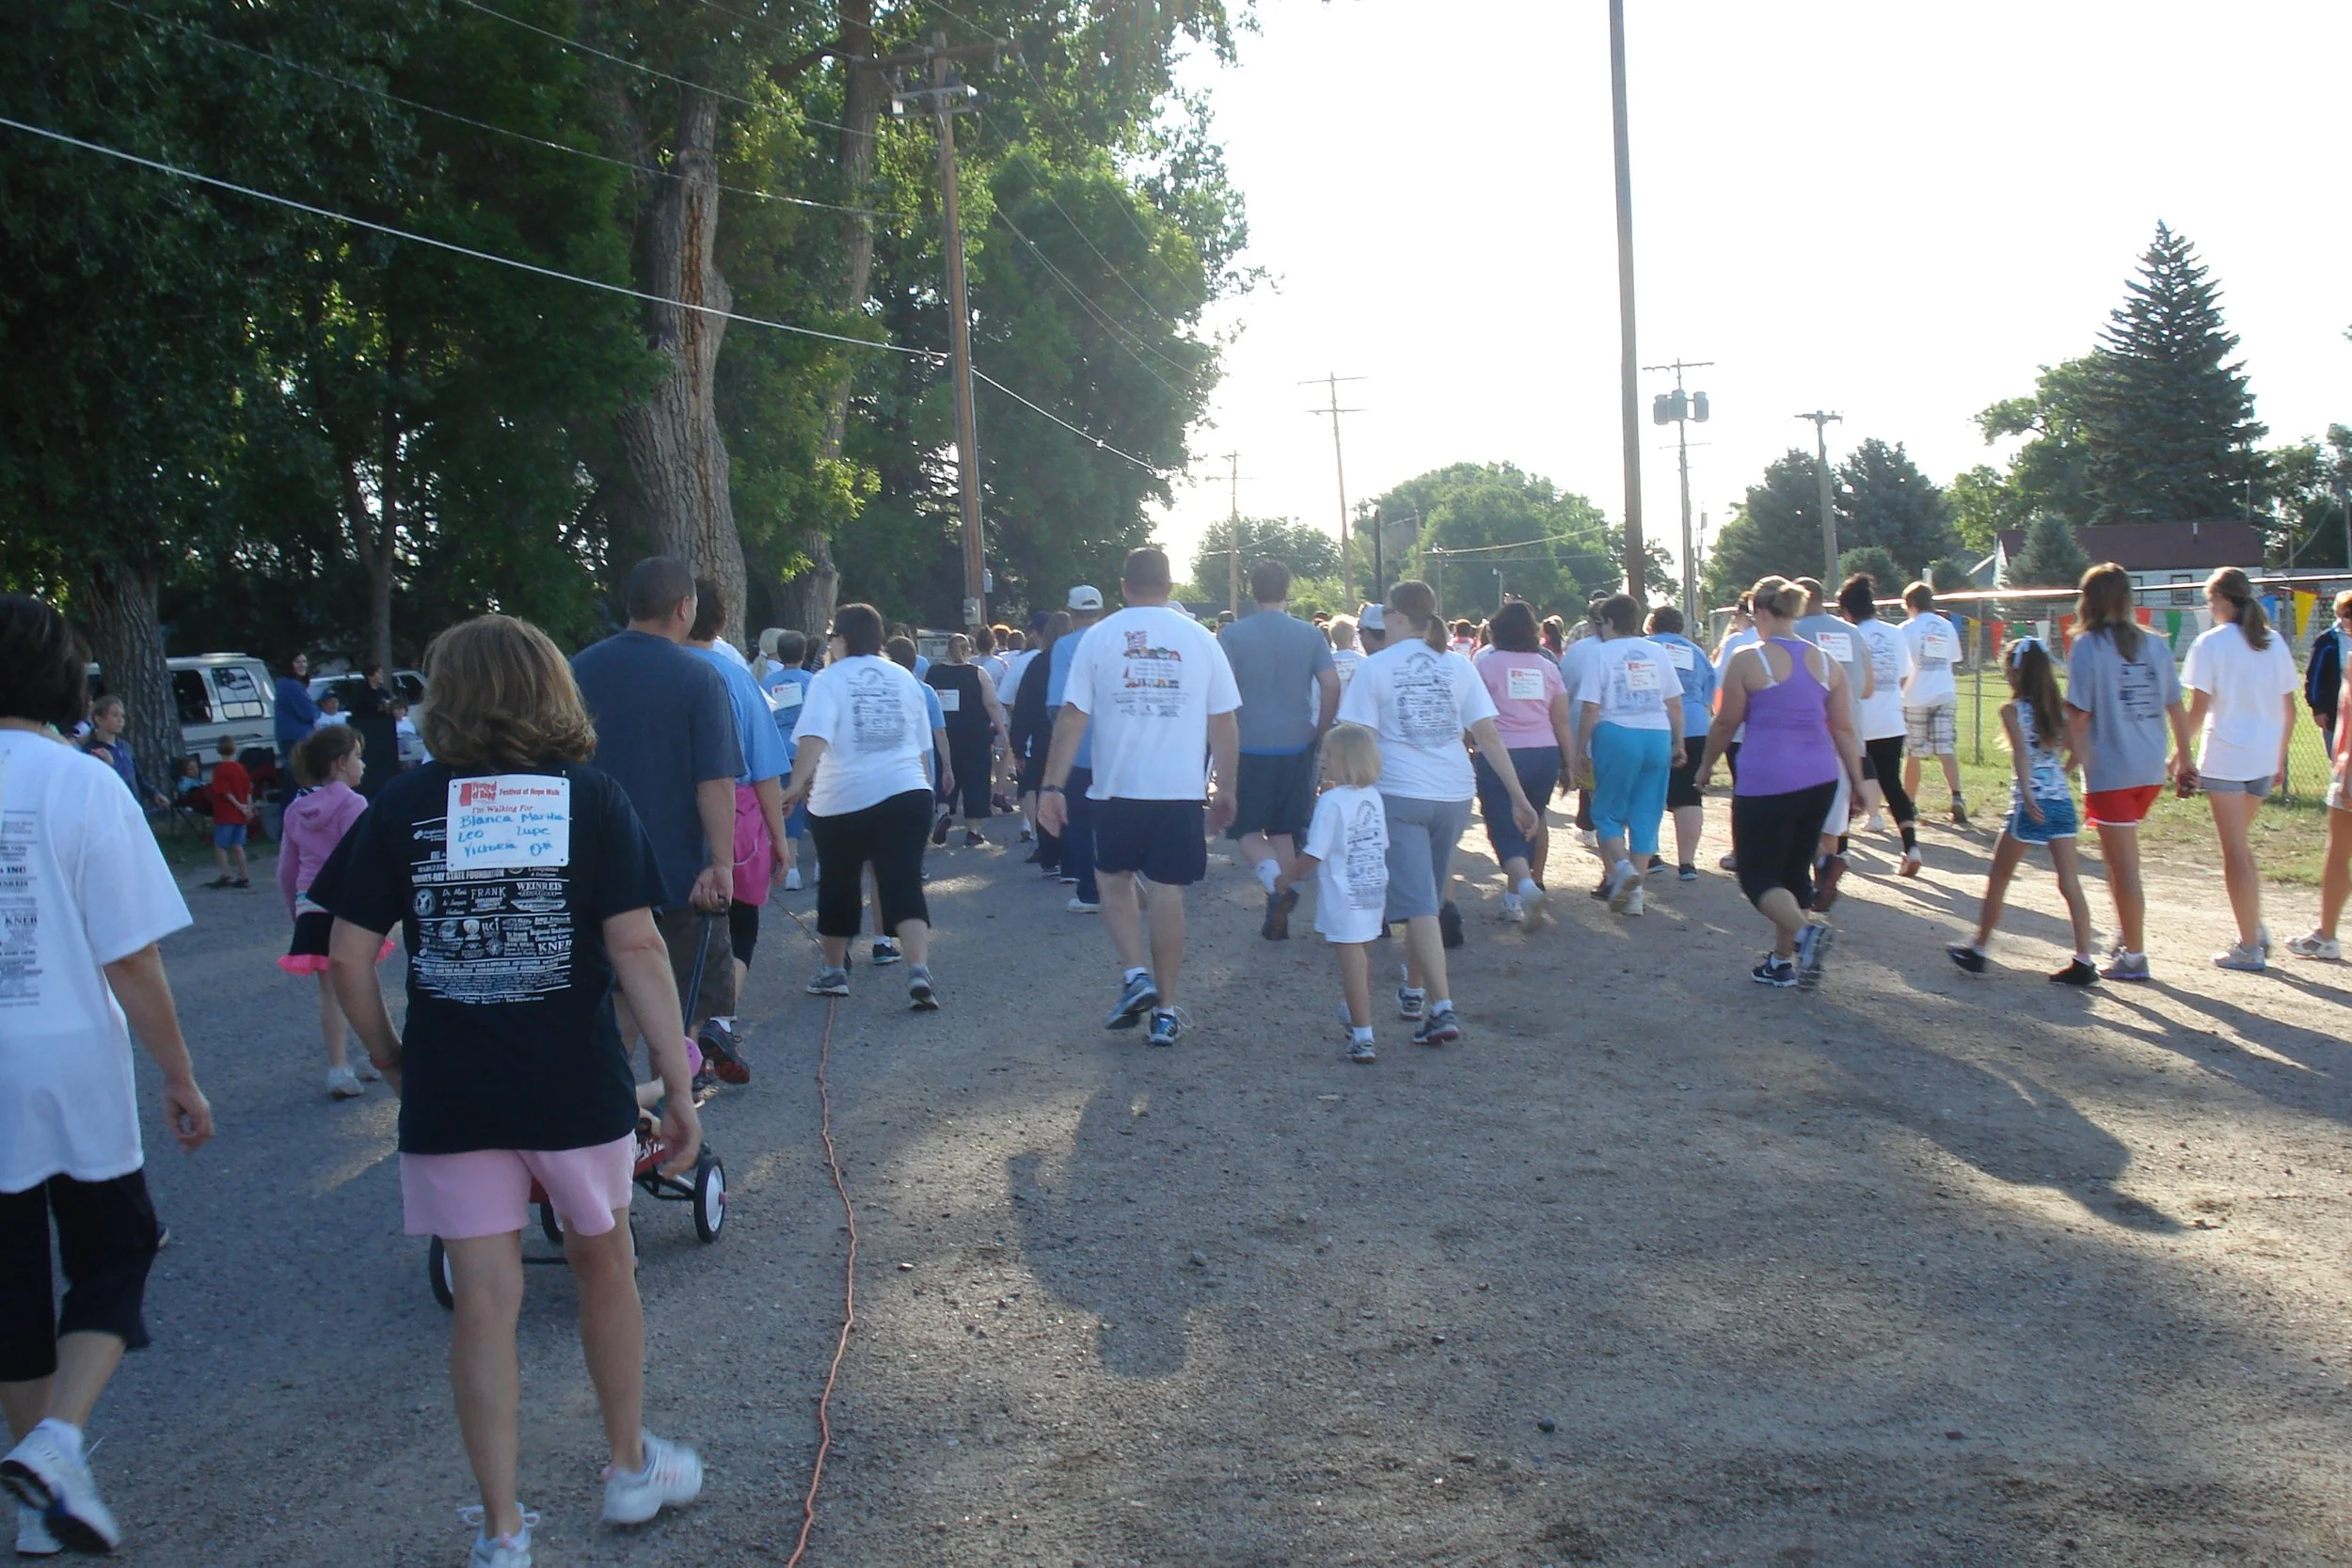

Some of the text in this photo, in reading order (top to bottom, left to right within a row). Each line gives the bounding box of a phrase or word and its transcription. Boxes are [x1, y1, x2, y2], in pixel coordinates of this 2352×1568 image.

[530, 788, 545, 797] Hope
[460, 815, 513, 829] Blanca
[516, 881, 563, 891] WEINREIS
[470, 887, 506, 899] FRANK
